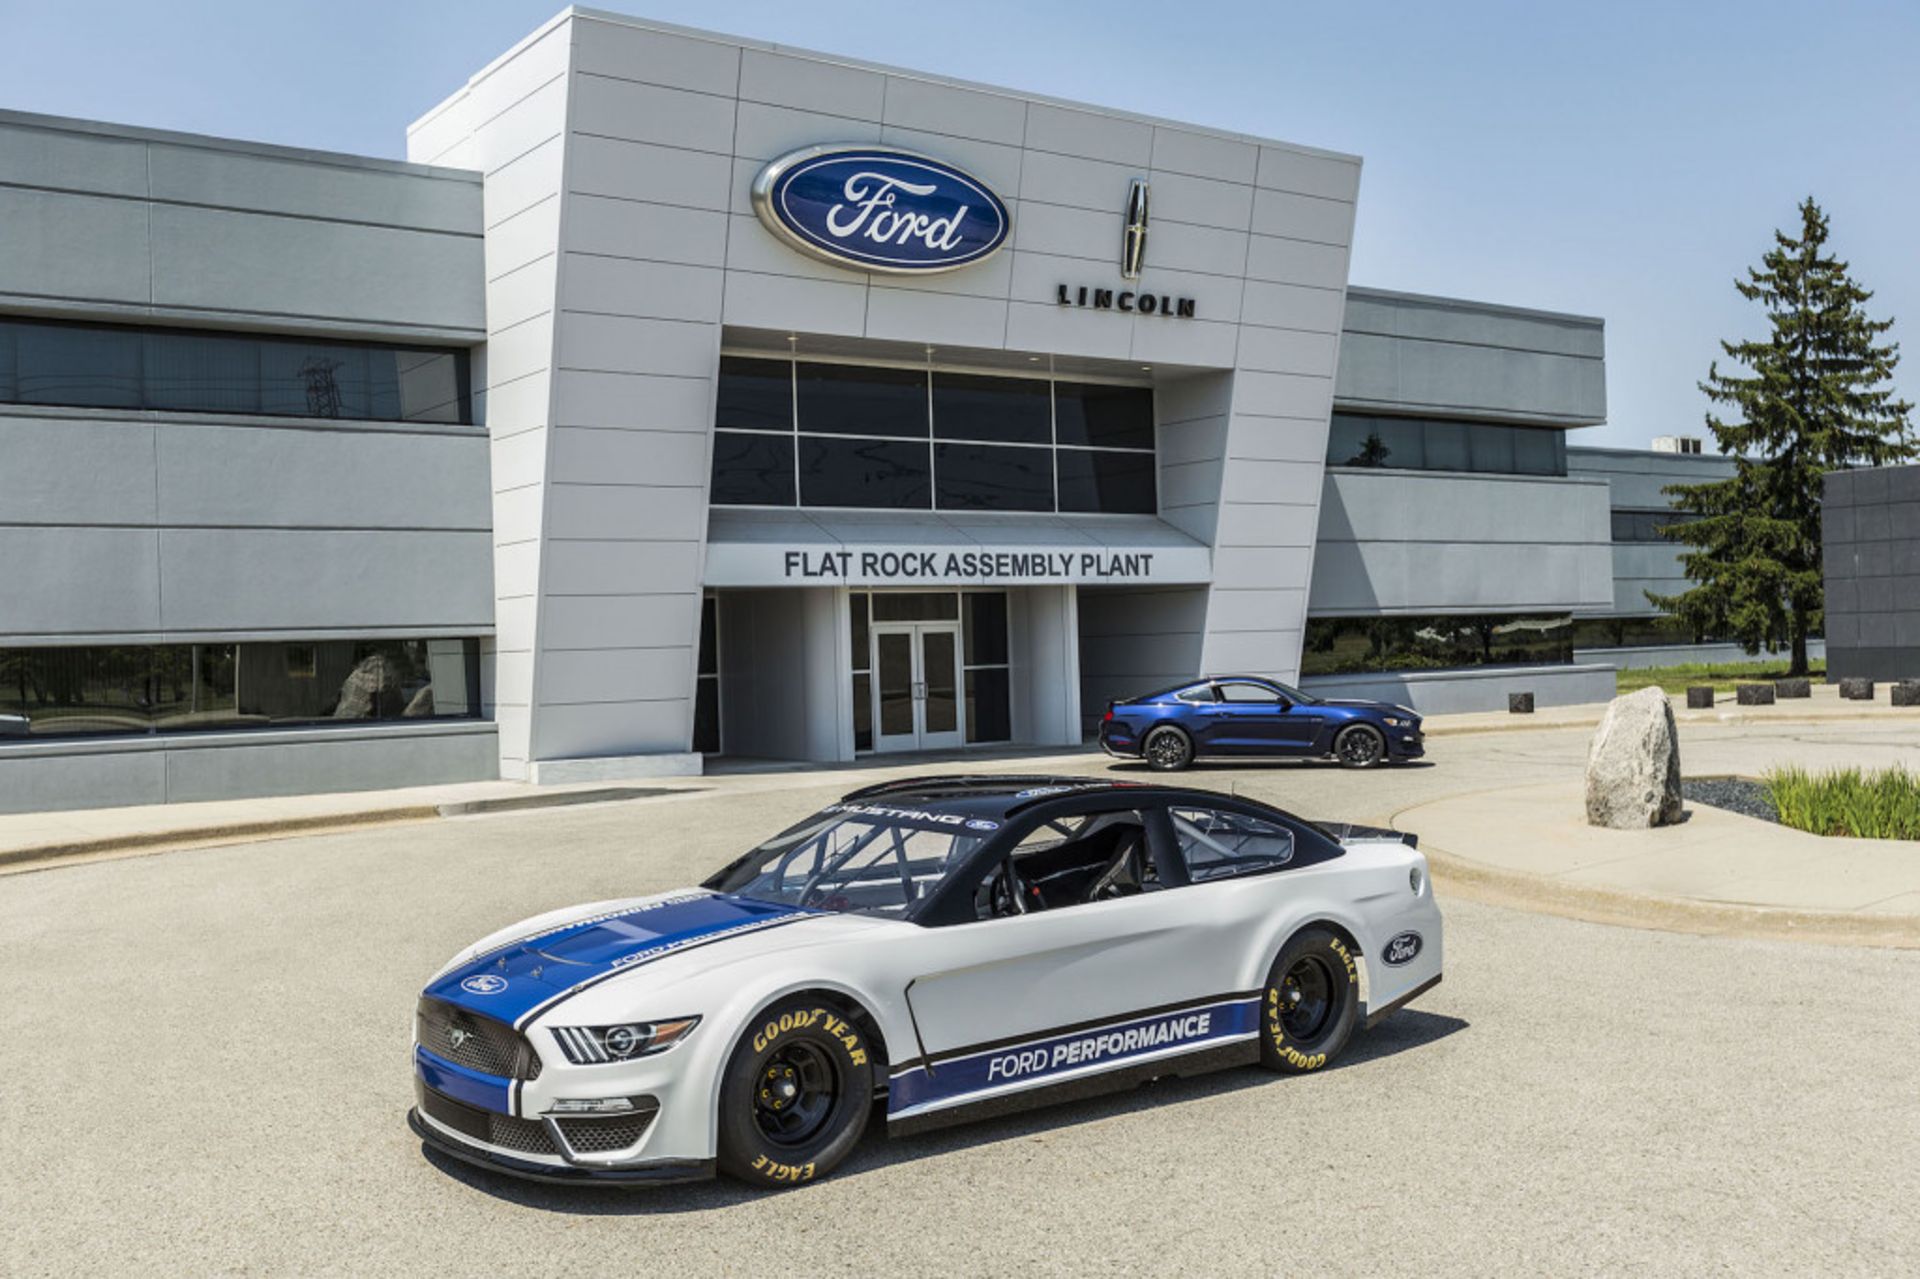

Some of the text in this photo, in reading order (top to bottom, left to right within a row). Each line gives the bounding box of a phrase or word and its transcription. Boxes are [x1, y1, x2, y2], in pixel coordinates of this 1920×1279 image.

[826, 171, 968, 250] Ford
[1058, 284, 1196, 318] LINCOLN
[784, 552, 1153, 577] FLAT ROCK ASSEMBLY PLANT
[842, 804, 965, 825] MUSTANG
[1329, 937, 1357, 984] EAGLE
[753, 1008, 867, 1066] GOODYEAR
[987, 1013, 1212, 1081] FORD PERFORMANCE
[1268, 987, 1327, 1069] GOODYEAR
[751, 1154, 816, 1180] EAGLE
